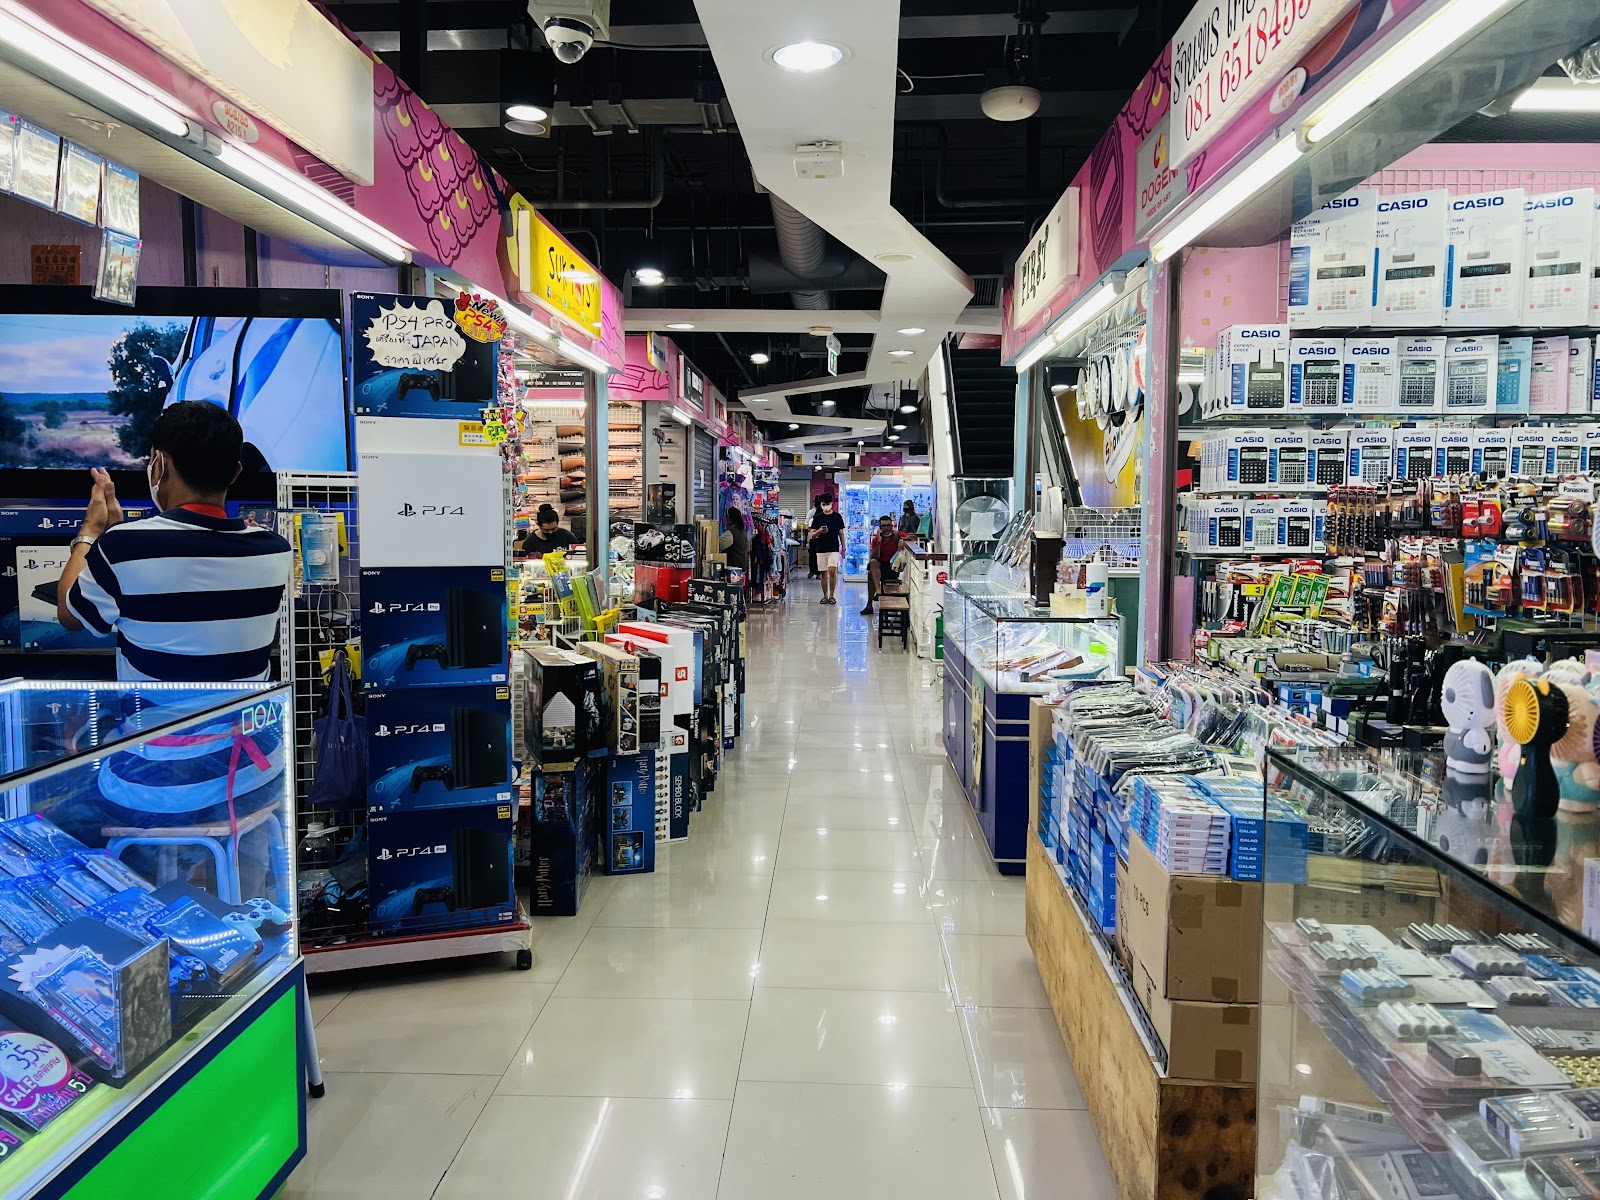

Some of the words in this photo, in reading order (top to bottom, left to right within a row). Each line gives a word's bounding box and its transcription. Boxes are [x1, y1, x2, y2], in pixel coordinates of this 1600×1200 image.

[1185, 72, 1211, 140] 081
[1318, 197, 1359, 210] ASIO
[1378, 198, 1428, 212] CASIO
[1453, 196, 1504, 211] CASIO
[1523, 196, 1574, 211] CASIO
[1022, 224, 1049, 306] FIRST
[382, 313, 418, 331] PS4
[423, 316, 453, 329] PRO
[464, 308, 492, 332] PS4
[1241, 330, 1280, 338] CASIO
[412, 334, 459, 349] JAPAN
[1299, 347, 1336, 355] CASIO
[1352, 347, 1390, 355] CASIO
[1455, 345, 1483, 353] CASIO
[422, 505, 465, 516] PS4
[389, 603, 425, 612] PS4
[428, 603, 440, 611] Pro
[394, 725, 431, 735] PS4
[674, 775, 683, 797] SEMBO
[674, 797, 682, 819] BLOCK
[396, 846, 433, 858] PS4
[1140, 892, 1150, 917] PCS
[4, 1075, 38, 1107] SALE
[68, 1079, 87, 1093] 5
